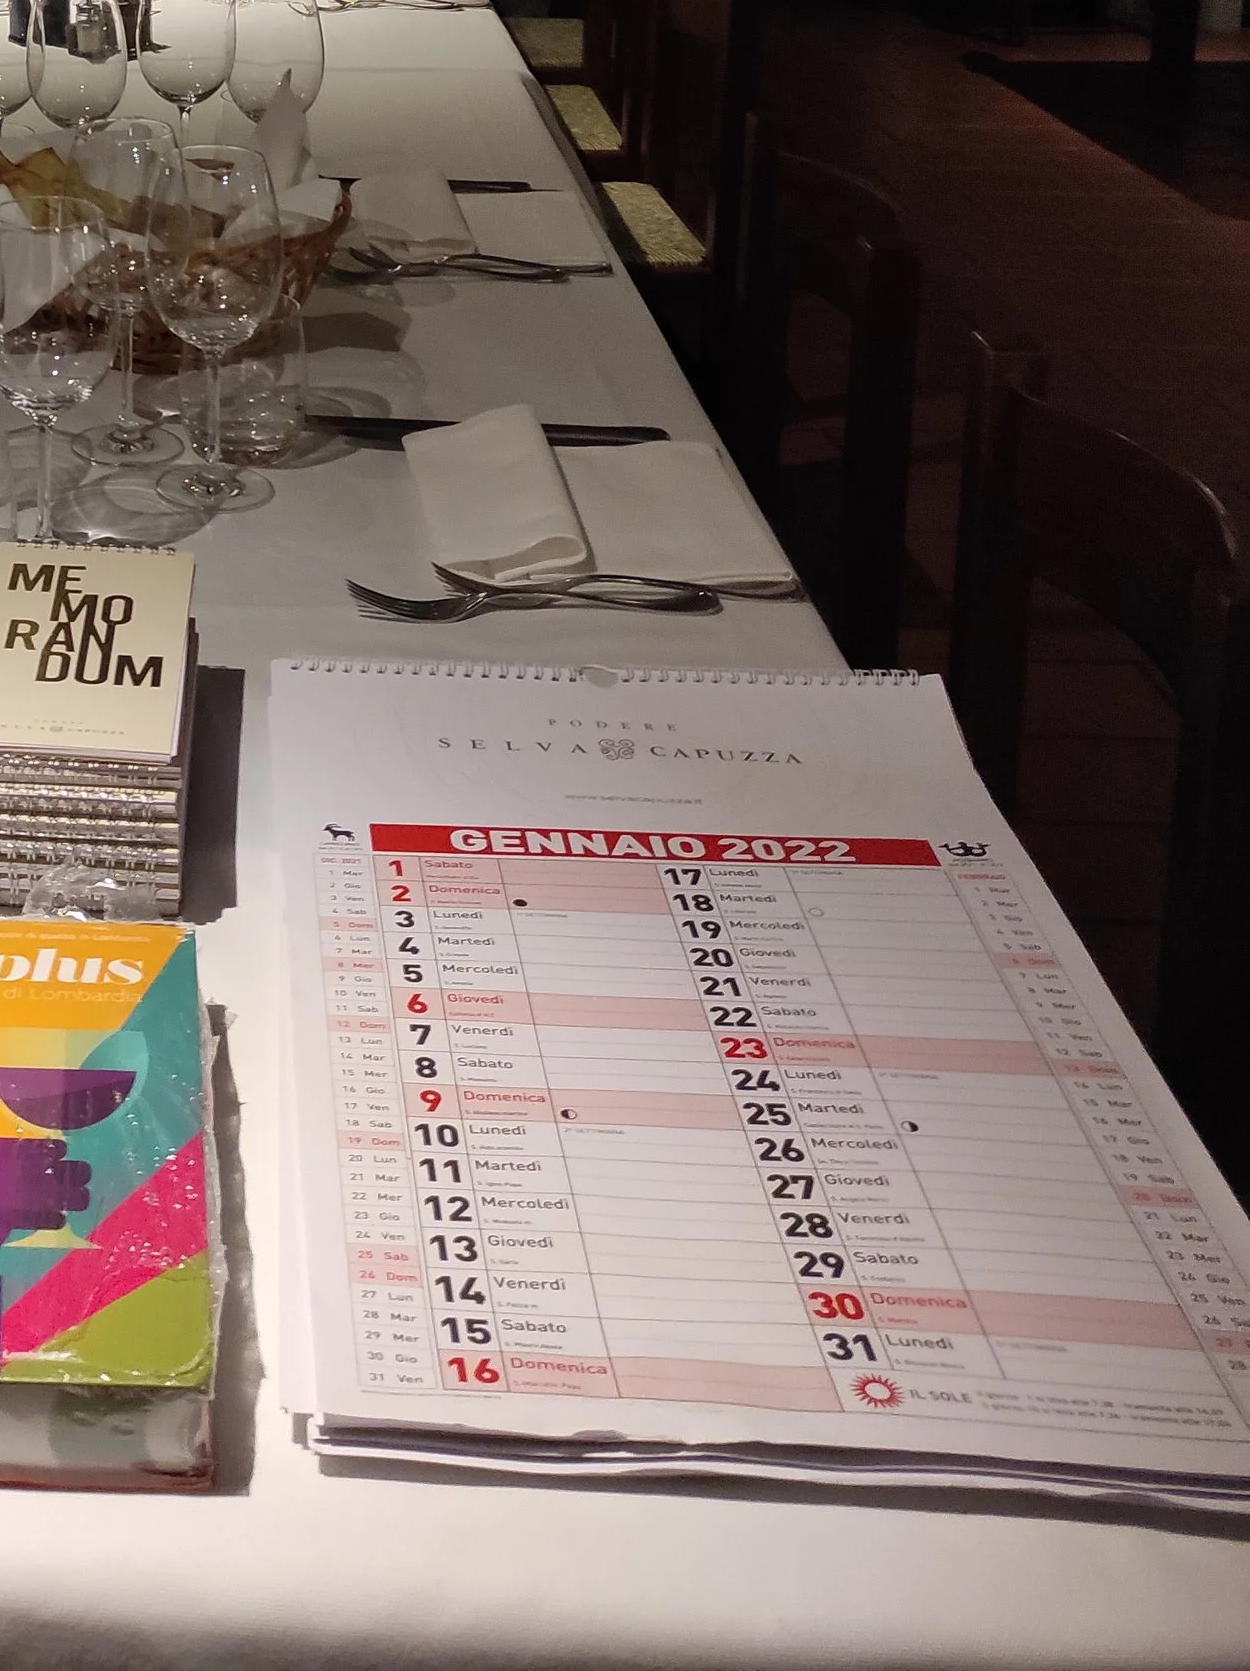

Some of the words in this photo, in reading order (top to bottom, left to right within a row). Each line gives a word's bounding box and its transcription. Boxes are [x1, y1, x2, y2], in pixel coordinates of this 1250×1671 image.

[548, 719, 678, 732] PODERE
[438, 737, 588, 754] SELVA
[650, 746, 803, 764] CAPUZZA
[450, 829, 707, 858] GENNAIO
[719, 838, 857, 863] 2022
[389, 860, 403, 876] 1
[424, 860, 473, 869] Sabato
[664, 868, 701, 885] 17
[391, 885, 412, 902] 2
[429, 885, 500, 895] Domenica
[673, 894, 713, 911] 18
[395, 911, 415, 928] 3
[682, 921, 721, 939] 19
[398, 937, 419, 955] 4
[690, 948, 734, 967] 20
[402, 964, 423, 982] 5
[2, 988, 22, 1000] di
[29, 988, 142, 1003] Lombardia
[700, 977, 741, 996] 21
[407, 993, 428, 1013] 6
[710, 1006, 757, 1027] 22
[761, 1006, 816, 1016] Sabato
[410, 1024, 431, 1045] 7
[720, 1037, 767, 1059] 23
[773, 1037, 856, 1049] Domenica
[364, 1070, 388, 1078] Mer
[415, 1057, 437, 1078] 8
[458, 1057, 513, 1069] Sabato
[731, 1069, 780, 1091] 24
[419, 1090, 442, 1112] 9
[464, 1090, 546, 1103] Domenica
[743, 1103, 791, 1125] 25
[369, 1120, 392, 1128] Sab
[372, 1138, 400, 1146] Dom
[414, 1123, 459, 1147] 10
[755, 1138, 804, 1162] 26
[374, 1156, 397, 1164] Lun
[376, 1174, 400, 1182] Mar
[419, 1158, 462, 1183] 11
[767, 1174, 814, 1199] 27
[378, 1193, 403, 1201] Mer
[379, 1212, 400, 1221] Gio
[424, 1196, 472, 1221] 12
[780, 1212, 833, 1238] 28
[356, 1231, 371, 1239] 24
[381, 1231, 405, 1241] Ven
[358, 1250, 373, 1259] 25
[384, 1251, 408, 1261] Sab
[429, 1235, 478, 1262] 13
[794, 1251, 844, 1278] 29
[853, 1252, 919, 1264] Sabato
[360, 1271, 375, 1280] 26
[386, 1272, 418, 1281] Dom
[361, 1290, 377, 1298] 27
[388, 1293, 413, 1302] Lun
[435, 1276, 486, 1304] 14
[808, 1292, 864, 1320] 30
[870, 1293, 967, 1309] Domenica
[364, 1310, 379, 1319] 28
[390, 1313, 417, 1323] Mar
[365, 1331, 381, 1340] 29
[393, 1333, 420, 1343] Mer
[441, 1317, 492, 1344] 15
[501, 1319, 567, 1333] Sabato
[823, 1333, 877, 1361] 31
[367, 1352, 384, 1361] 30
[395, 1354, 417, 1363] Gio
[370, 1373, 383, 1381] 31
[397, 1375, 423, 1384] Ven
[447, 1358, 500, 1383] 16
[510, 1358, 607, 1375] Domenica
[930, 1391, 972, 1403] SOLE
